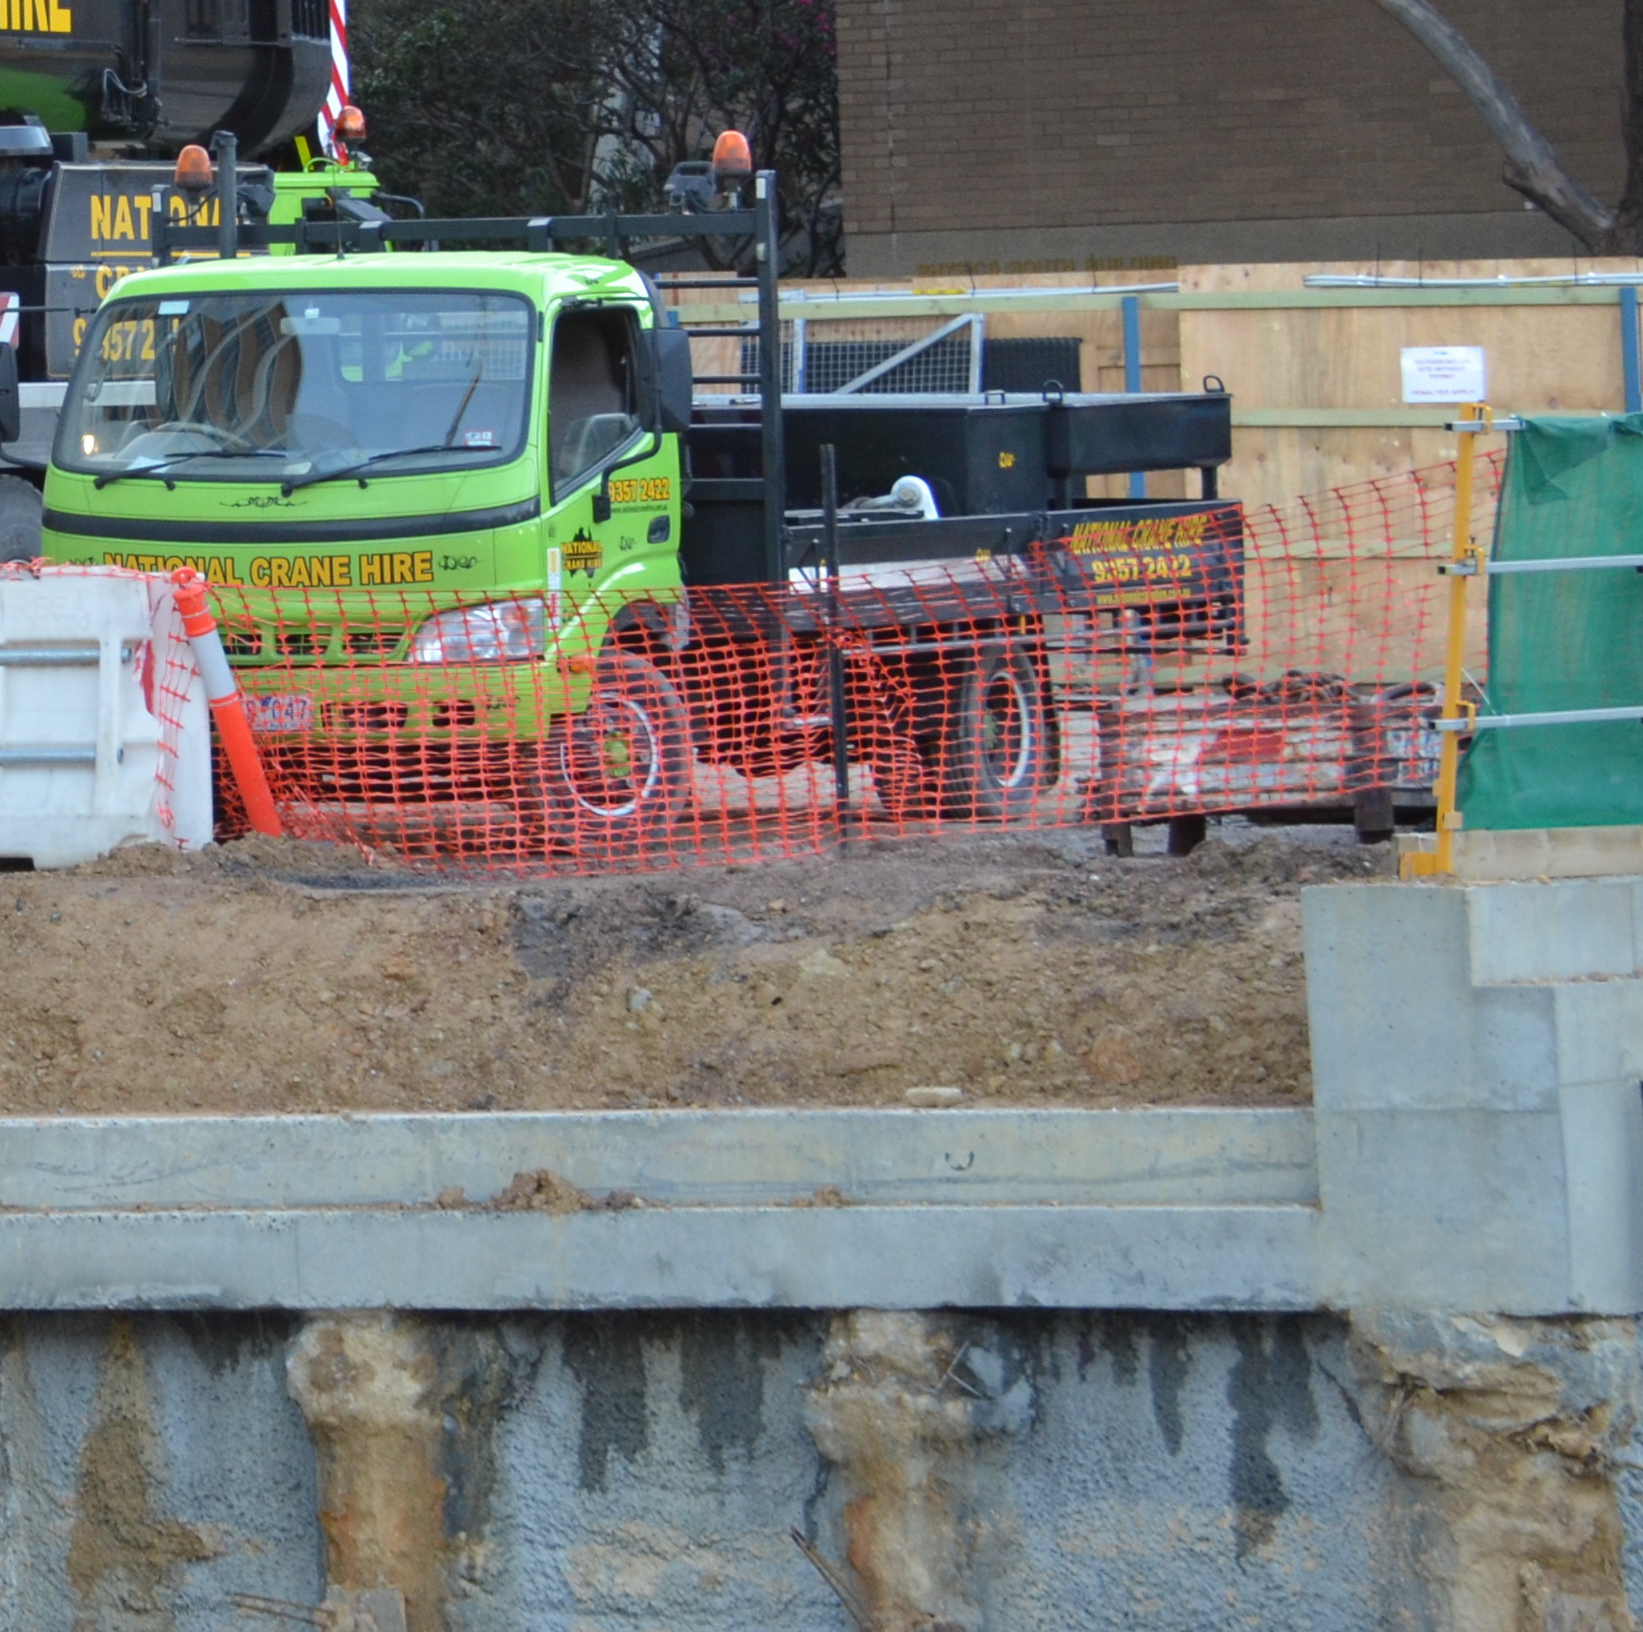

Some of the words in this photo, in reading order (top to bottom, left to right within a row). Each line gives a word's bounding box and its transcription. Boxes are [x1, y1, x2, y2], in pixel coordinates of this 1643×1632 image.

[608, 480, 638, 502] 9357
[640, 478, 670, 500] 2422
[250, 555, 352, 587] CRANE
[359, 551, 434, 585] HIRE
